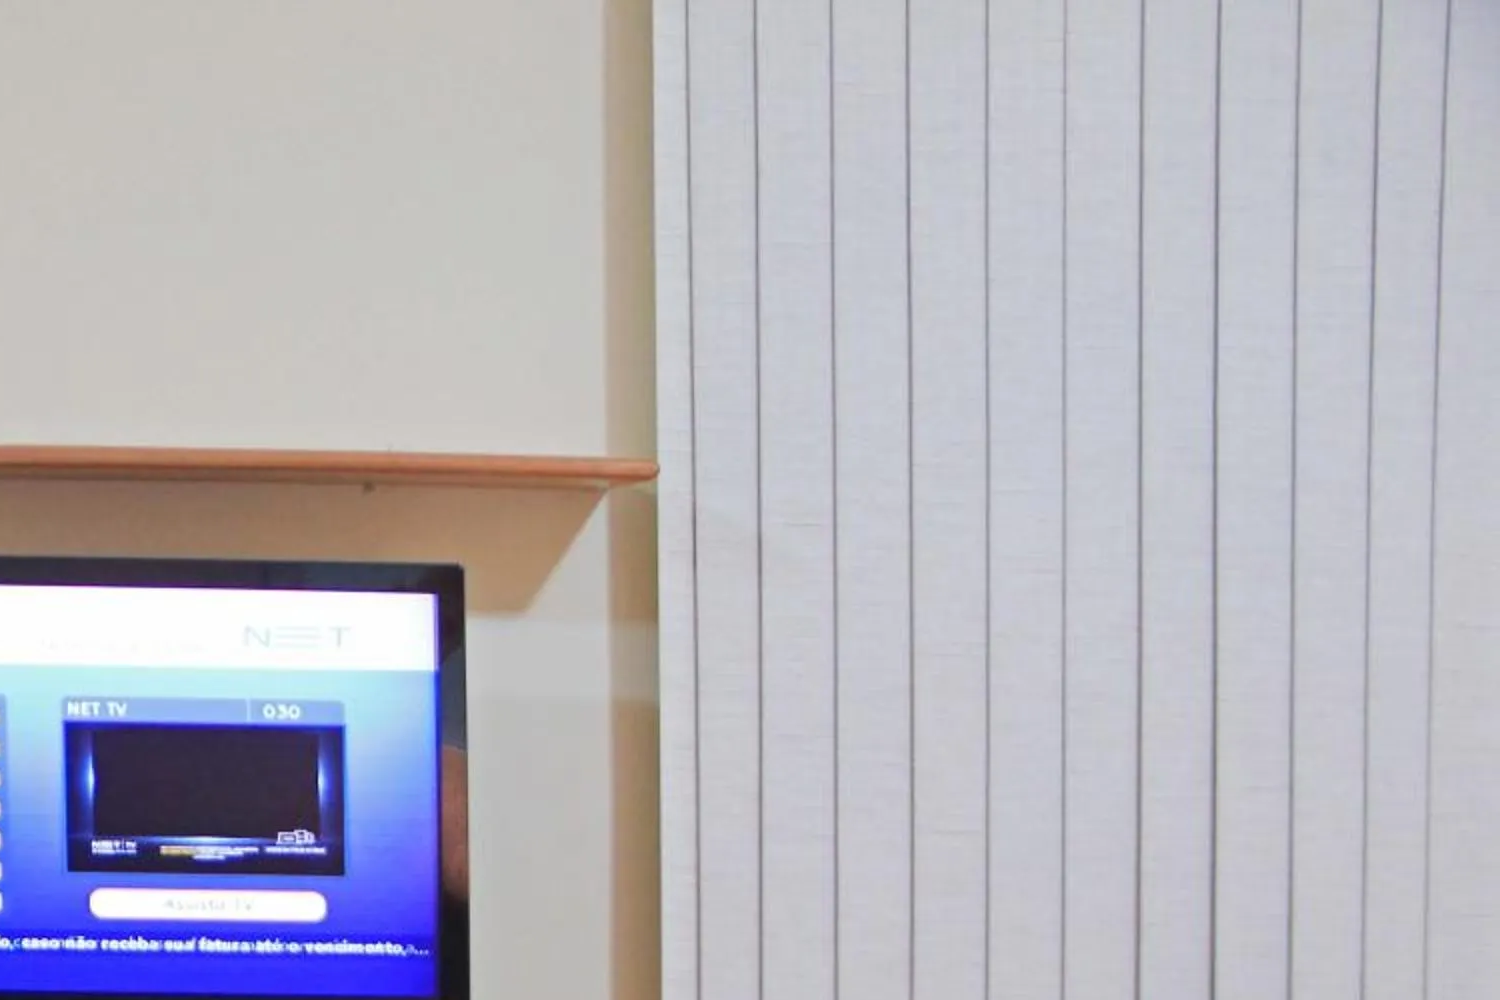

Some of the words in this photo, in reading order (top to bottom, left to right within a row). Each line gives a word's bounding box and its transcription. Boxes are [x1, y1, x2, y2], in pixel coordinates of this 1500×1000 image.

[241, 624, 353, 648] NET
[67, 701, 100, 717] NET
[106, 701, 128, 717] TV
[263, 703, 301, 720] 030
[64, 936, 97, 951] não
[198, 937, 251, 953] fatura
